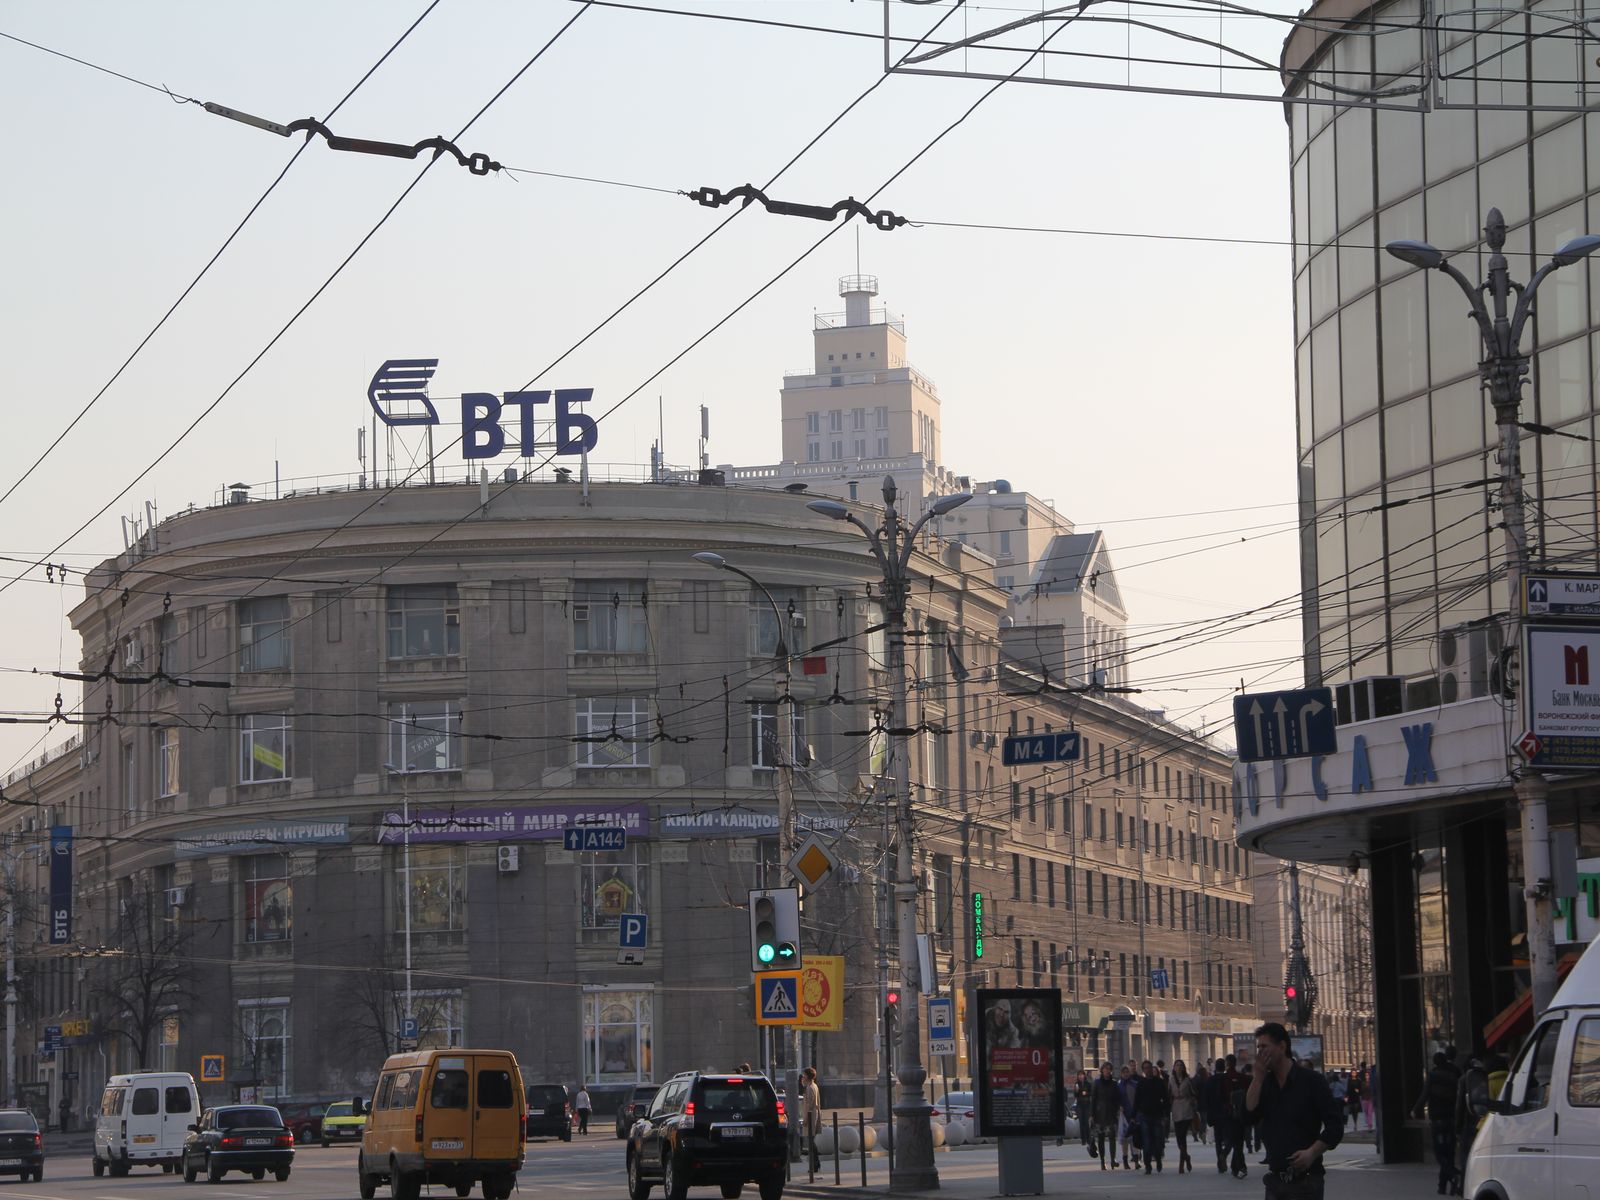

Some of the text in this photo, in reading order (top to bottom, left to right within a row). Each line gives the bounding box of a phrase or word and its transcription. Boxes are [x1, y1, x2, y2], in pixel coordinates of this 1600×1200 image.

[461, 388, 598, 459] ВТБ
[1576, 583, 1600, 593] МАР
[1551, 689, 1600, 707] Банк Москв
[407, 812, 640, 834] КНИЖНЫЙ МИР СЕМЬИ
[666, 813, 713, 828] КНИГИ
[284, 823, 346, 840] ИГРУШКИ
[586, 832, 623, 847] А144
[54, 909, 68, 939] ВТБ
[626, 919, 641, 944] P
[404, 1021, 415, 1036] P
